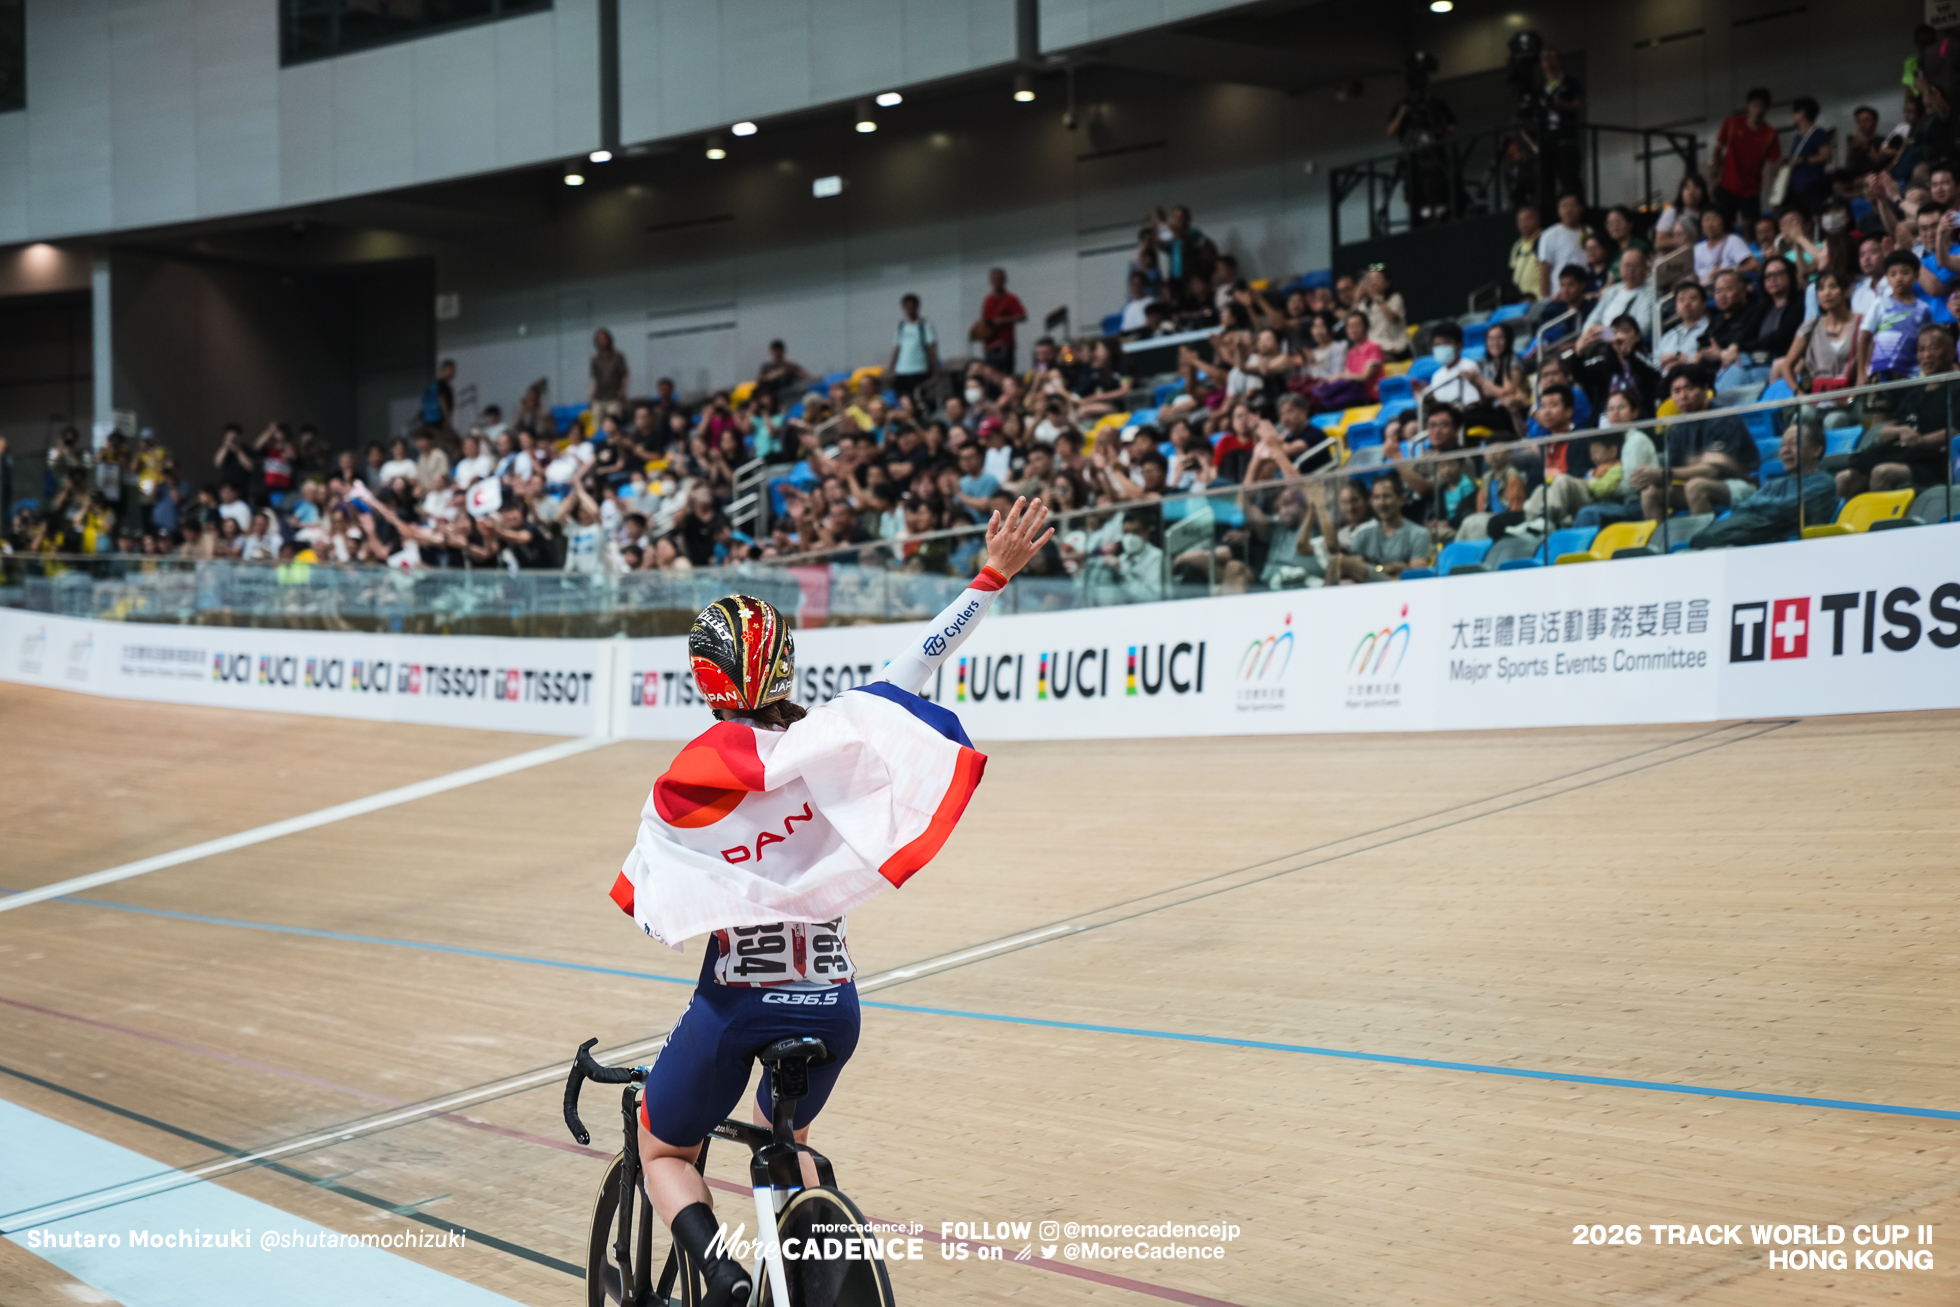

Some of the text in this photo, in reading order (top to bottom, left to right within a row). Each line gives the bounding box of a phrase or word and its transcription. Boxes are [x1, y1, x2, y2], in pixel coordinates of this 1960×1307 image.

[944, 600, 980, 638] Cyclers
[1450, 598, 1711, 650] 大型體育活動事務委員會
[220, 653, 251, 682] UCI
[267, 655, 298, 686] UCI
[312, 657, 344, 689] UCI
[360, 660, 392, 693] UCI
[425, 666, 490, 699] TISSOT
[970, 654, 1023, 702] UCI
[1051, 648, 1108, 699] UCI
[1141, 641, 1206, 695] UCI
[1450, 646, 1707, 685] Major Sports Events Committee
[523, 670, 593, 705] TISSOT
[662, 672, 700, 706] TIS
[703, 690, 738, 702] APAN
[795, 665, 873, 703] ISSOT
[761, 992, 839, 1006] Q36.5
